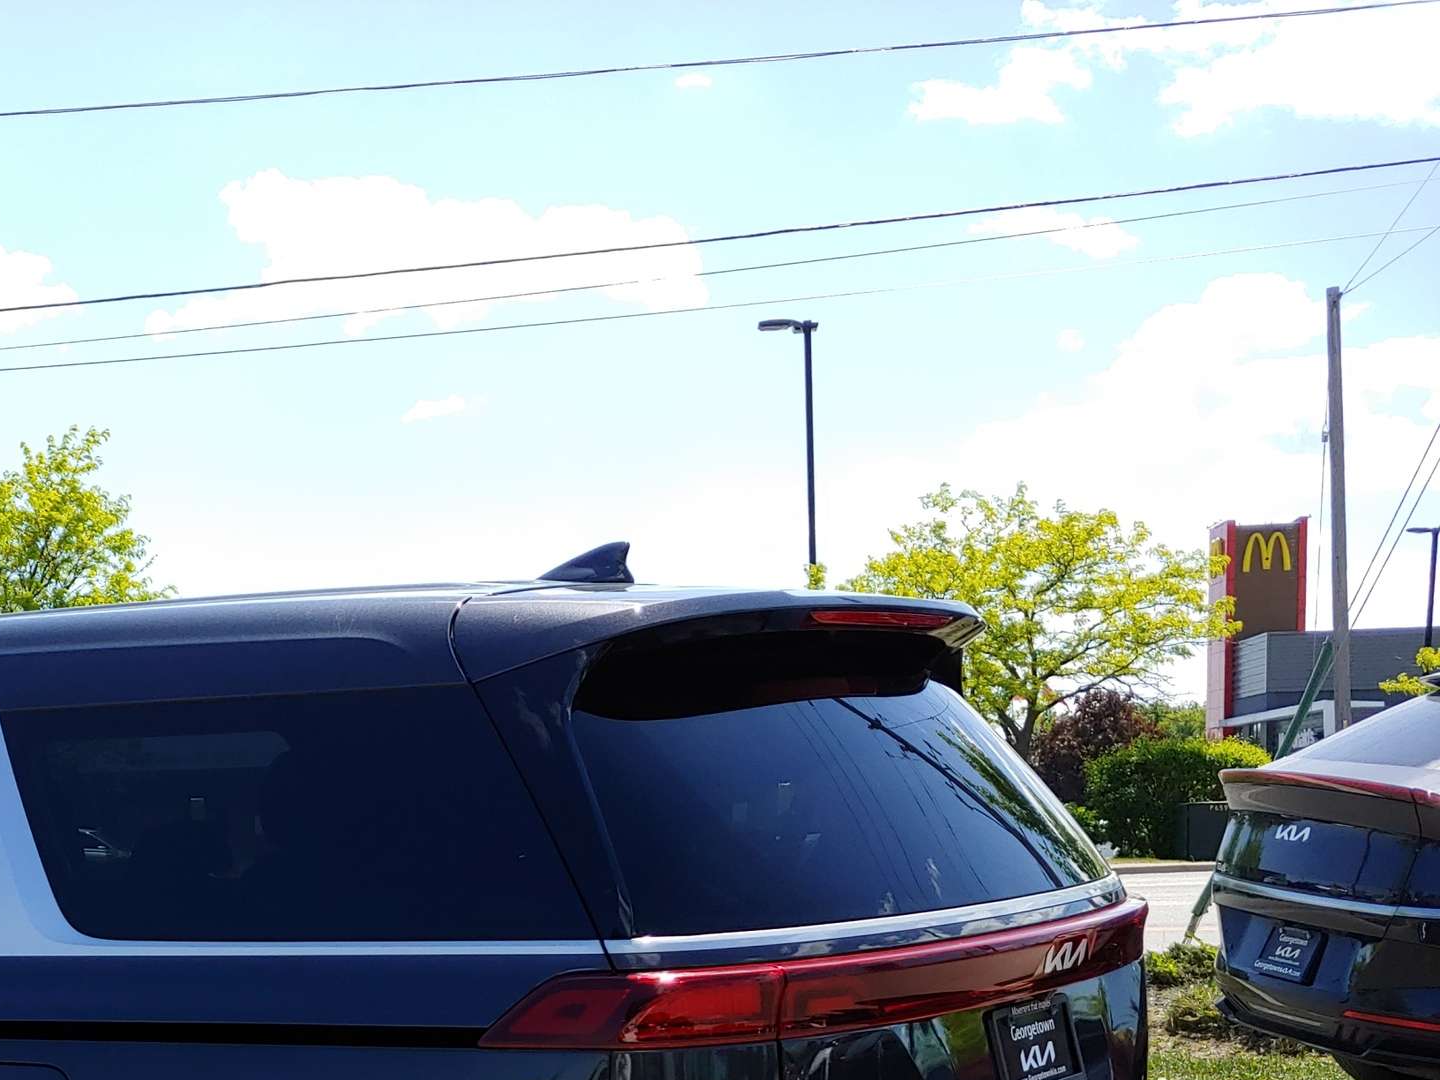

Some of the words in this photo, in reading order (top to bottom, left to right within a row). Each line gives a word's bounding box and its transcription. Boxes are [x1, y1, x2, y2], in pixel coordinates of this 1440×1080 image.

[1275, 823, 1311, 842] KIA
[1044, 938, 1088, 974] KIA
[1010, 1018, 1056, 1041] Georgetown
[1020, 1040, 1056, 1072] KIA
